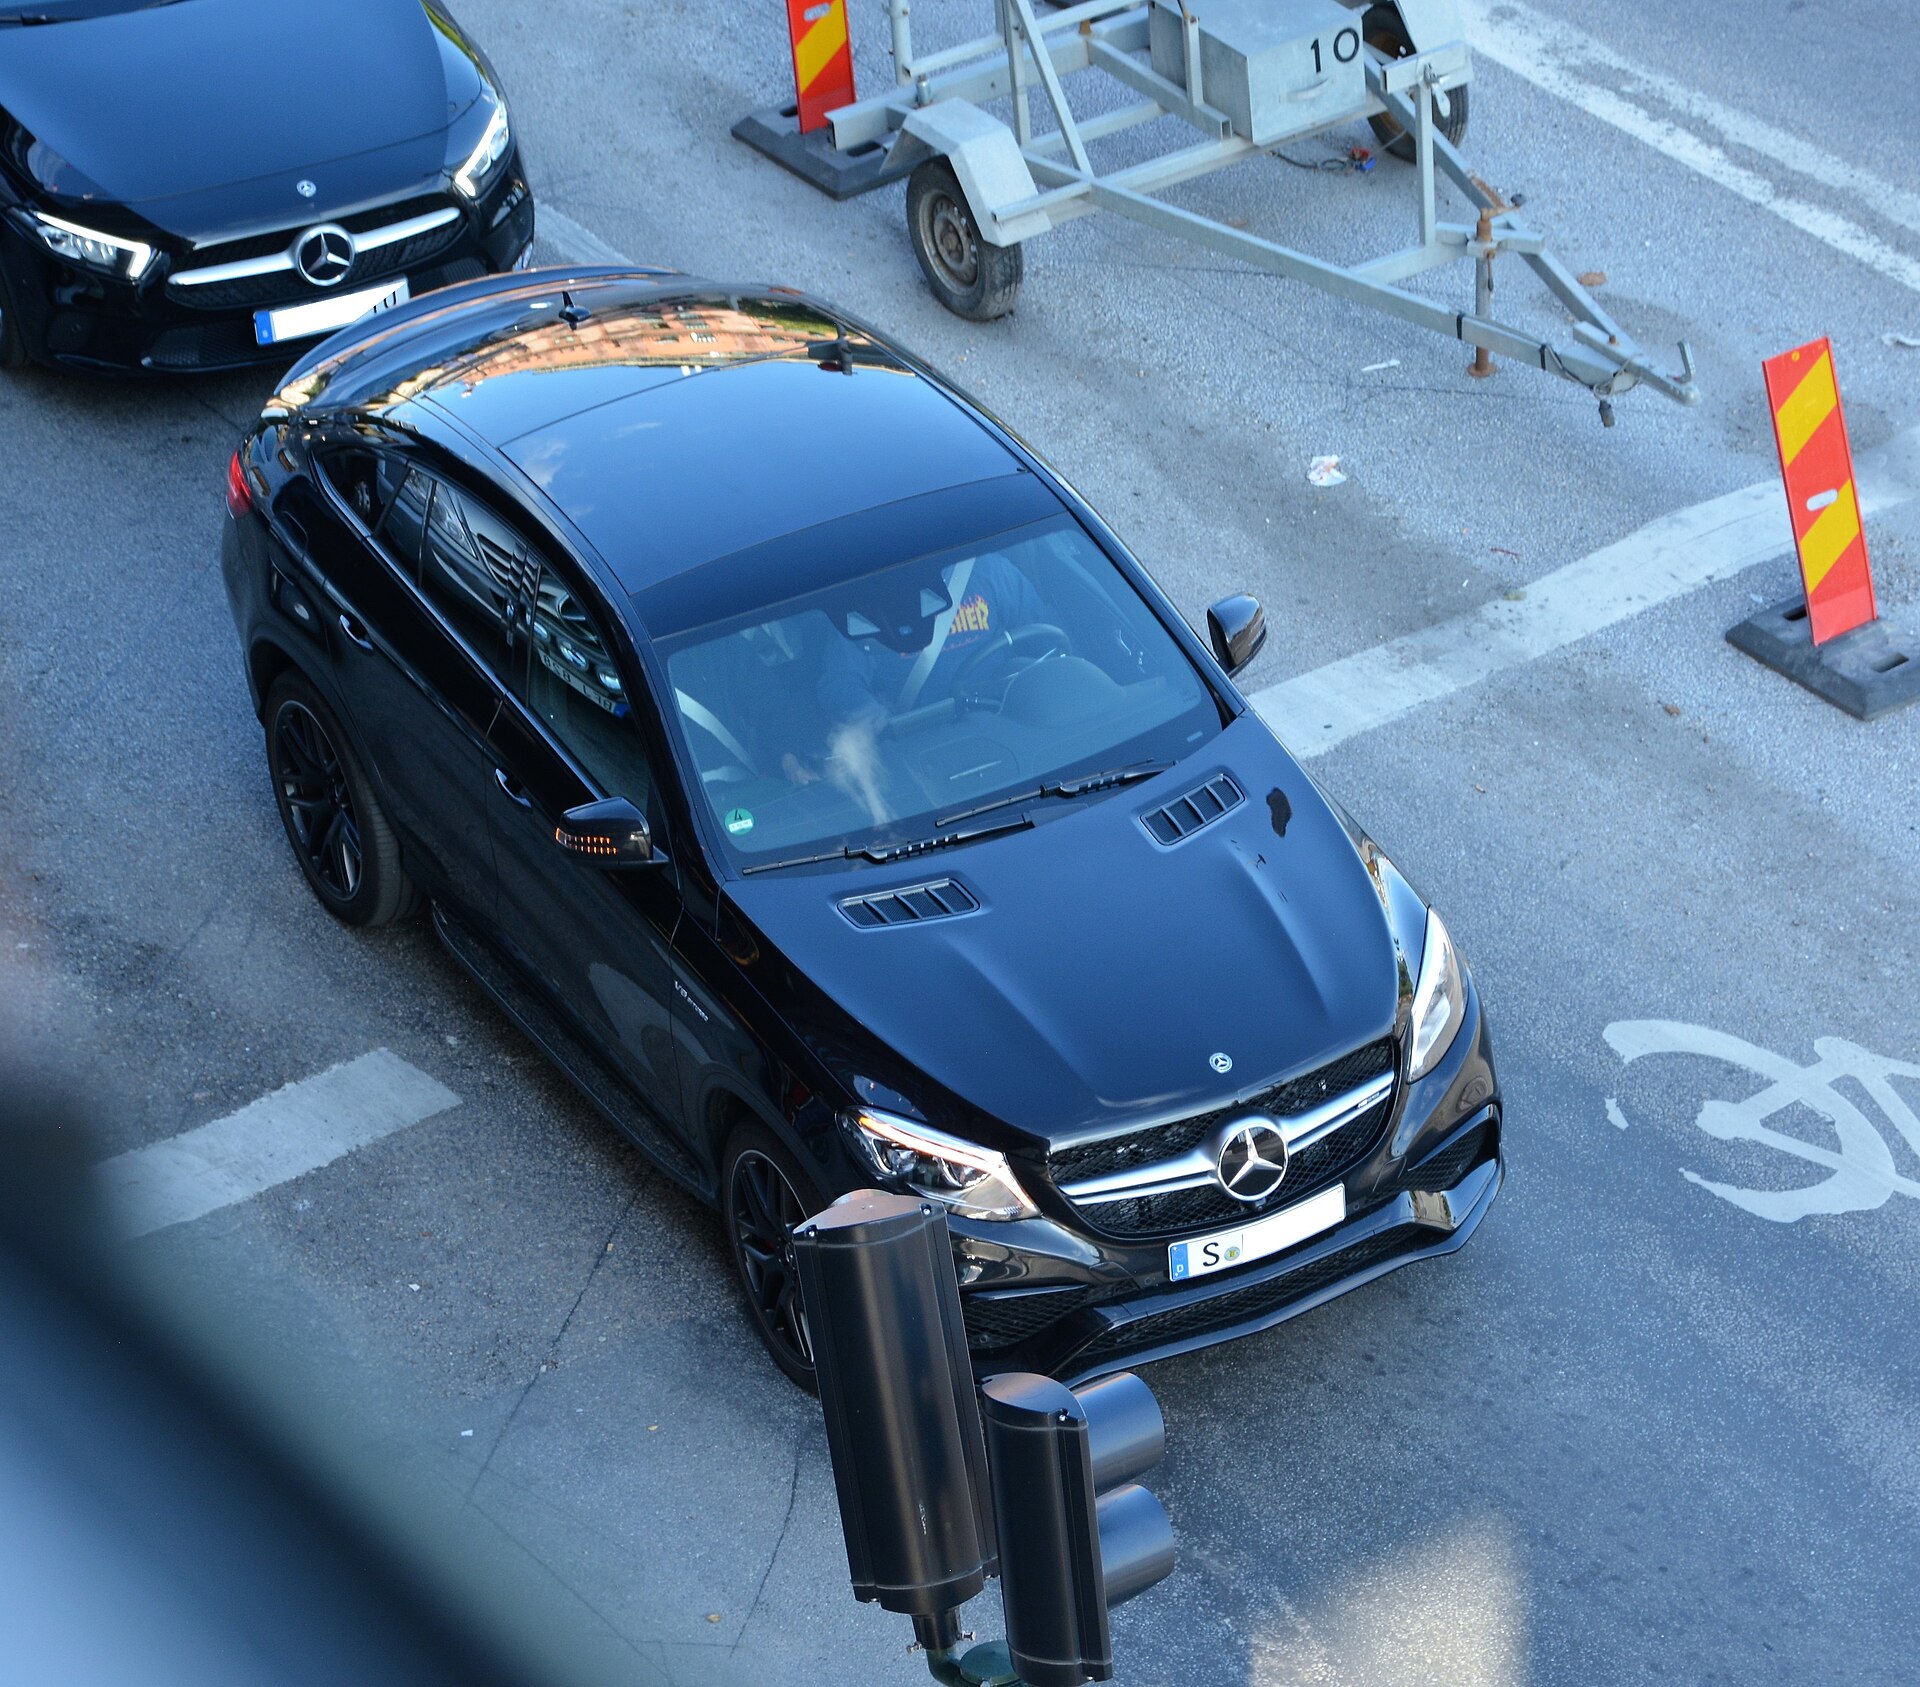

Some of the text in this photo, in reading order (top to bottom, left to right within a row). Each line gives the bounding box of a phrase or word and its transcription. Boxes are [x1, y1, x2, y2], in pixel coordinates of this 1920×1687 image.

[1310, 27, 1360, 73] 10
[1202, 1241, 1220, 1267] S
[1176, 1263, 1184, 1273] D
